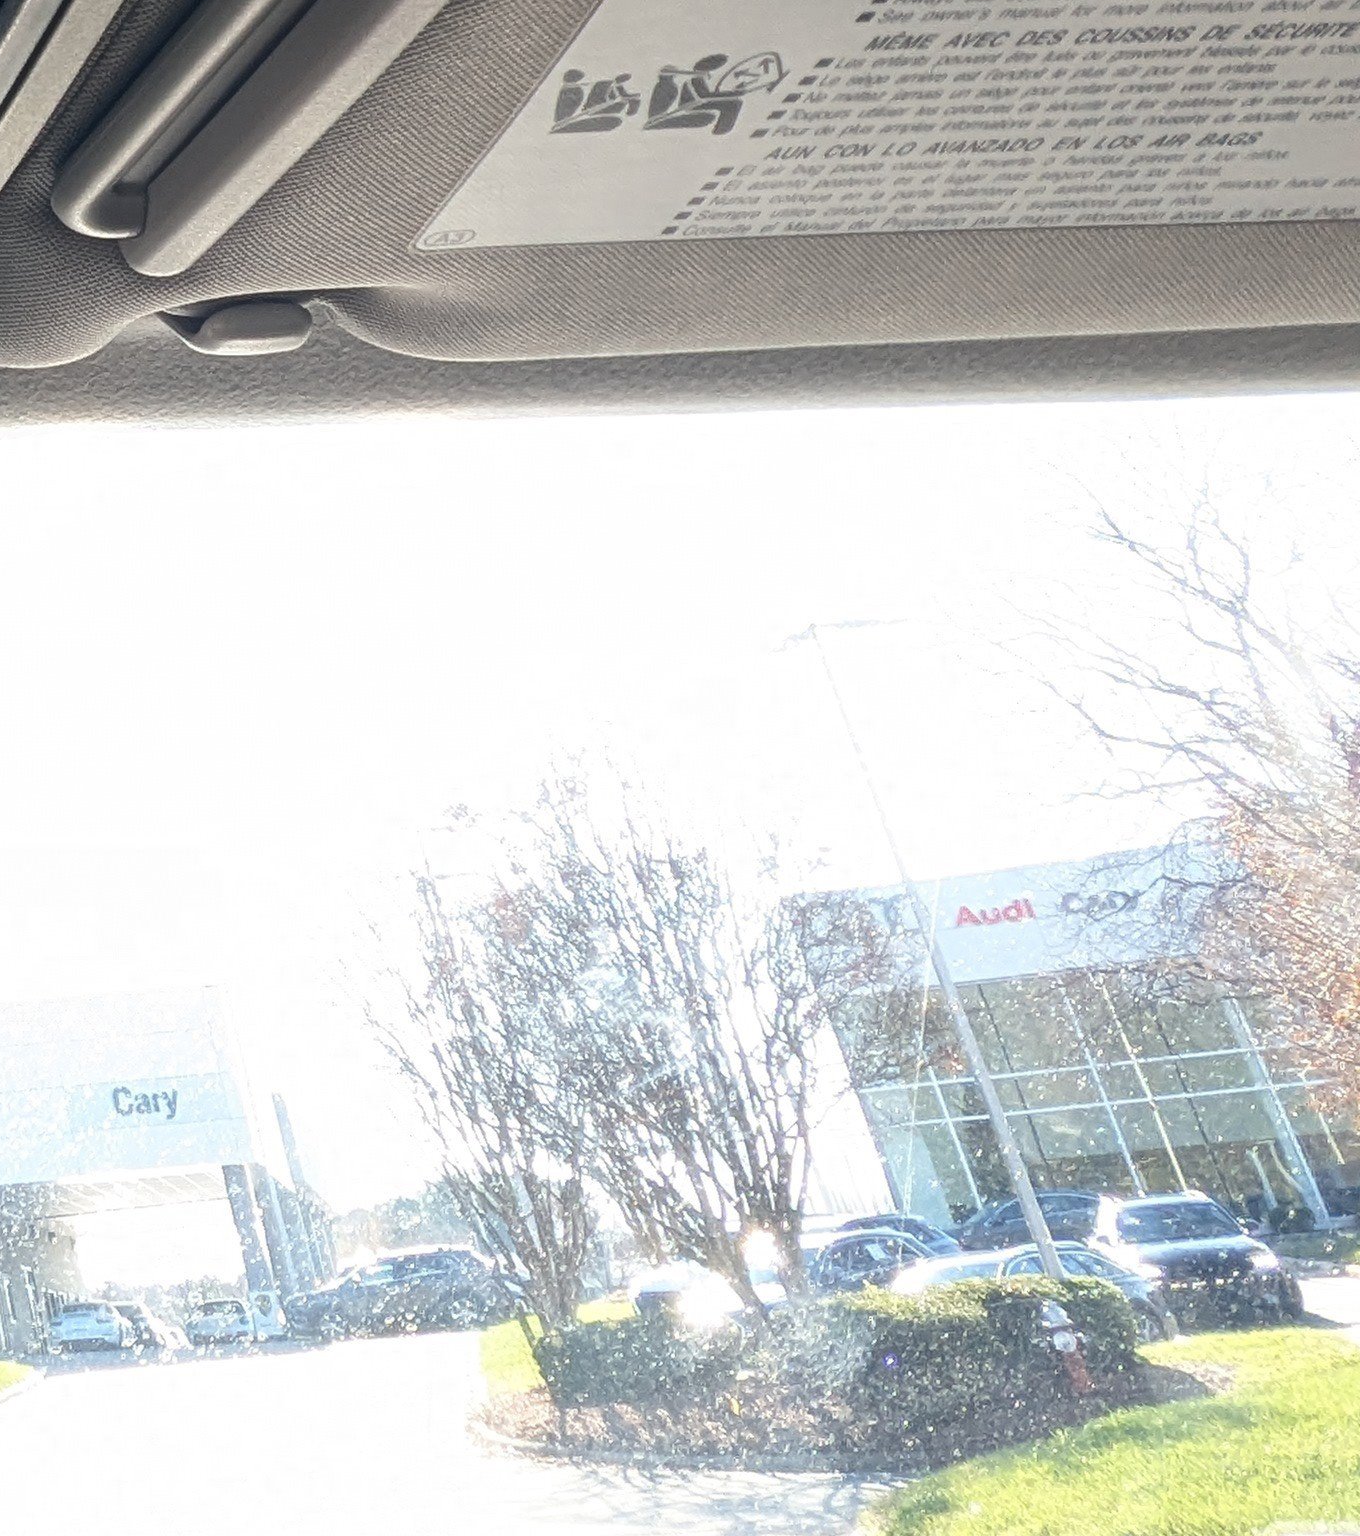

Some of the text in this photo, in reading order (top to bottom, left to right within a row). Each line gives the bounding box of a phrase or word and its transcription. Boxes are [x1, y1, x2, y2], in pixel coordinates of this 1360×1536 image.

[865, 30, 940, 52] MÊME
[941, 31, 1011, 50] AVEC
[1015, 28, 1069, 47] DES
[1074, 26, 1197, 45] COUSSINS
[1199, 24, 1242, 42] DE
[764, 130, 1264, 161] AUN CON LO AVANZADO EN LOS AIR BAGS
[957, 897, 1037, 926] Audi
[112, 1086, 178, 1120] Cary
